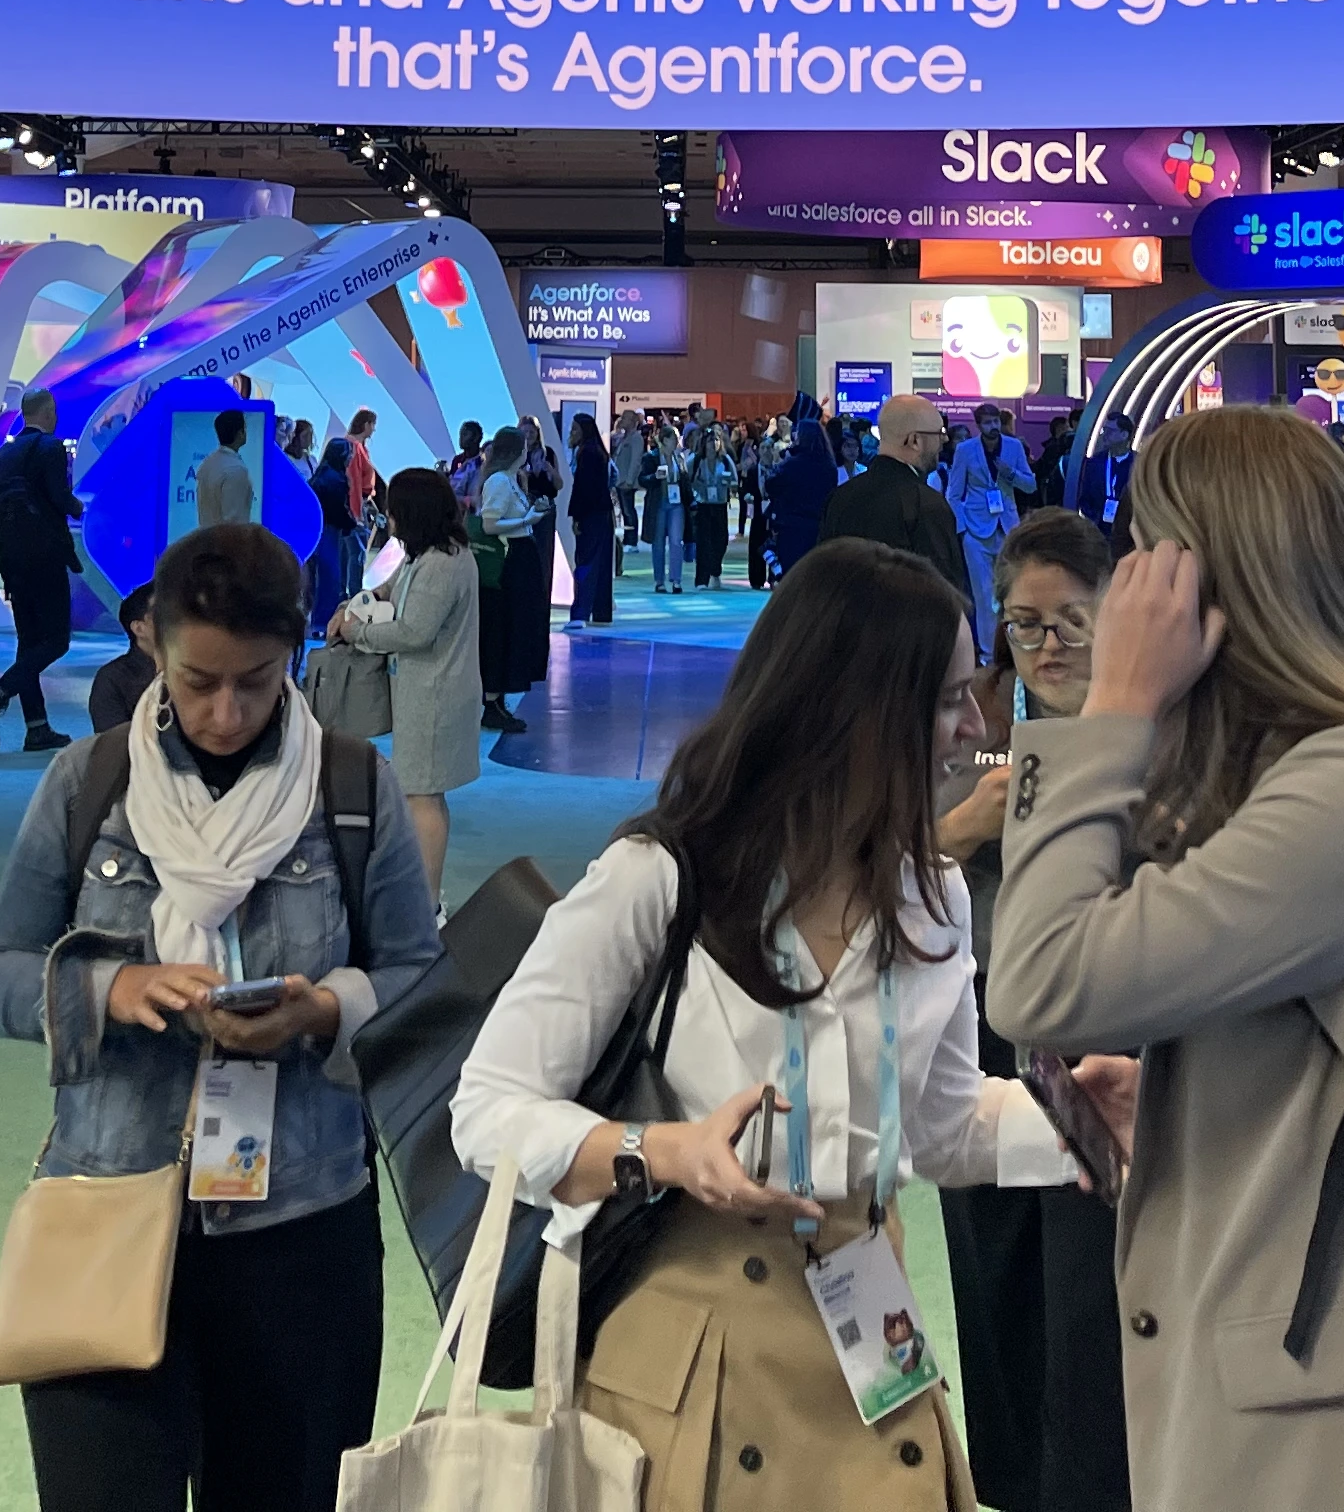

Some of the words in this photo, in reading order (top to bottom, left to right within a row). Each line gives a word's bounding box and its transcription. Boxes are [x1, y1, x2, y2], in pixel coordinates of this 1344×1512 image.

[552, 32, 982, 110] Agentforce.
[942, 129, 1108, 185] Slack
[65, 188, 204, 221] Platform
[801, 202, 902, 225] Salesforce
[907, 206, 934, 226] all
[940, 205, 960, 226] in
[966, 205, 1032, 227] Slack.
[999, 240, 1102, 266] Tableau
[1274, 258, 1298, 269] from
[220, 345, 240, 365] to
[243, 327, 272, 353] the
[277, 289, 341, 334] Agentic
[343, 242, 421, 296] Enterprise
[529, 283, 643, 306] Agentforce.
[553, 307, 593, 322] What
[596, 307, 613, 322] AI
[618, 307, 650, 323] Was
[1310, 315, 1334, 327] slac
[528, 324, 579, 339] Meant
[583, 325, 598, 339] to
[603, 325, 626, 339] Be.
